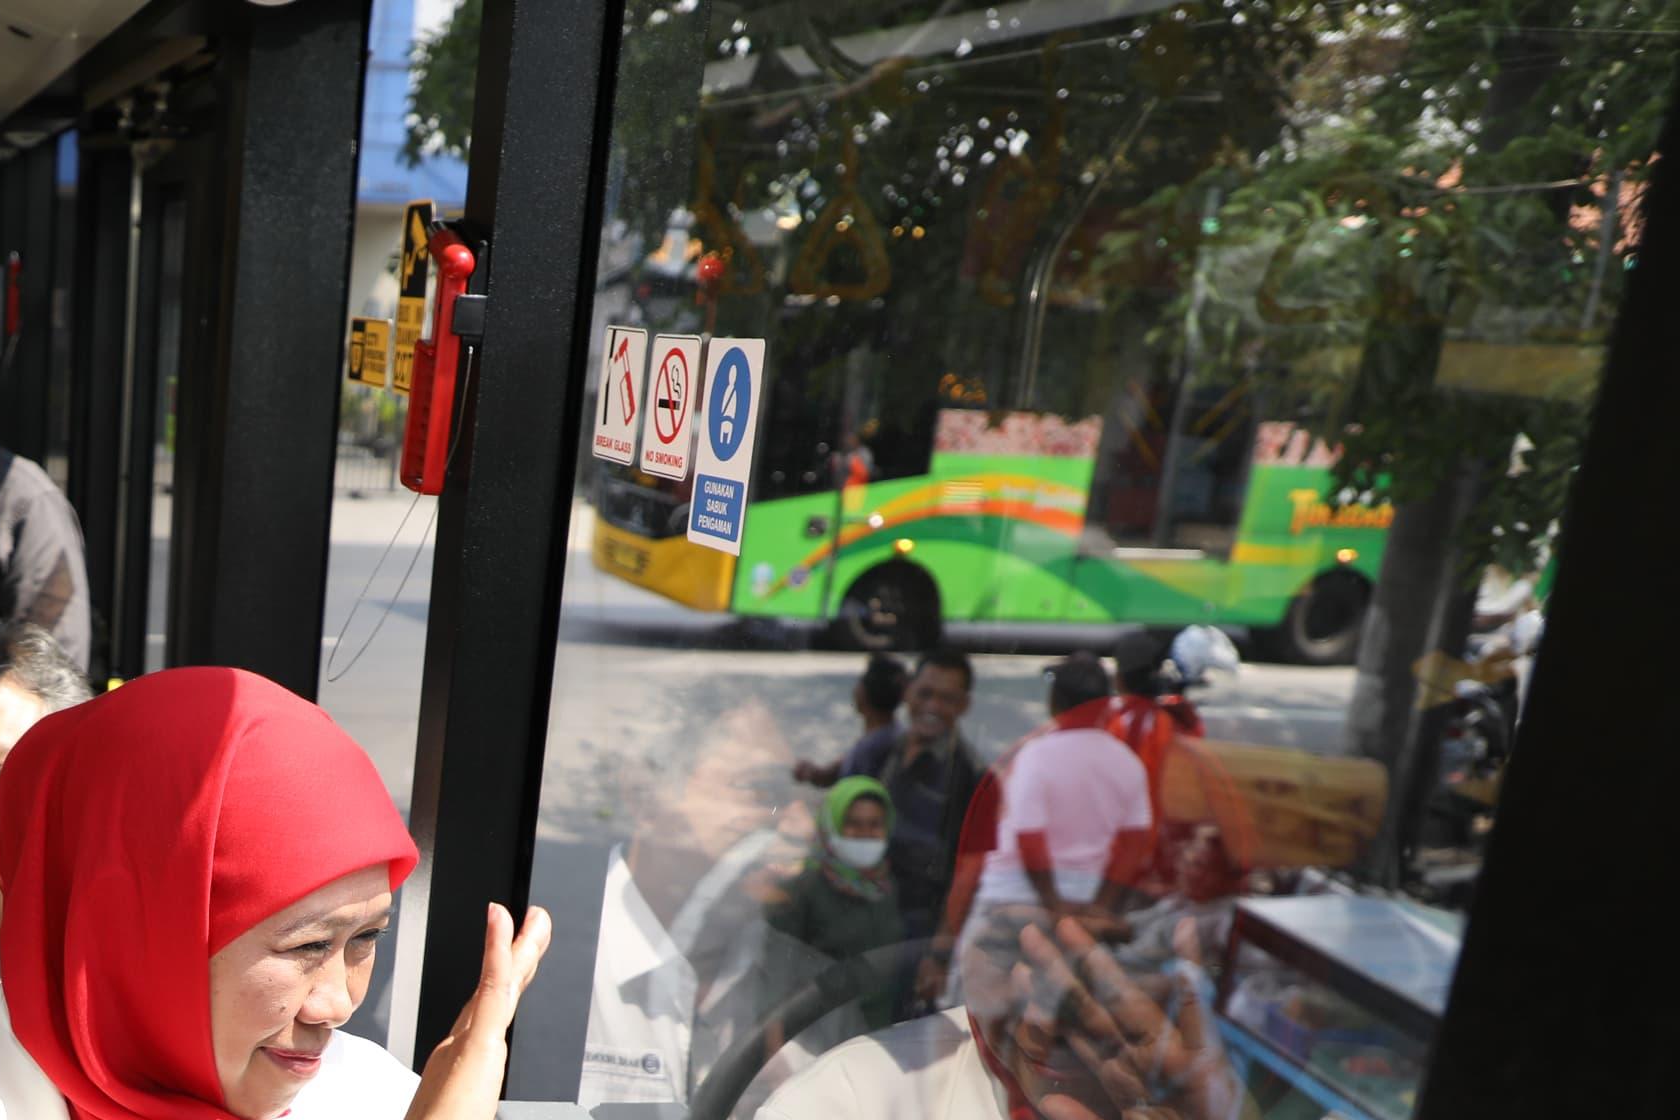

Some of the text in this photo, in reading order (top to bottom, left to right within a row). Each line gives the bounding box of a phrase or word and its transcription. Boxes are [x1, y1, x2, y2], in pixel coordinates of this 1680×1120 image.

[596, 435, 631, 454] BREAK GLASS
[645, 450, 682, 468] NO SMOKING
[704, 481, 734, 499] GUNAKAN
[706, 499, 728, 515] SABUK
[698, 514, 732, 535] PENGAMAN
